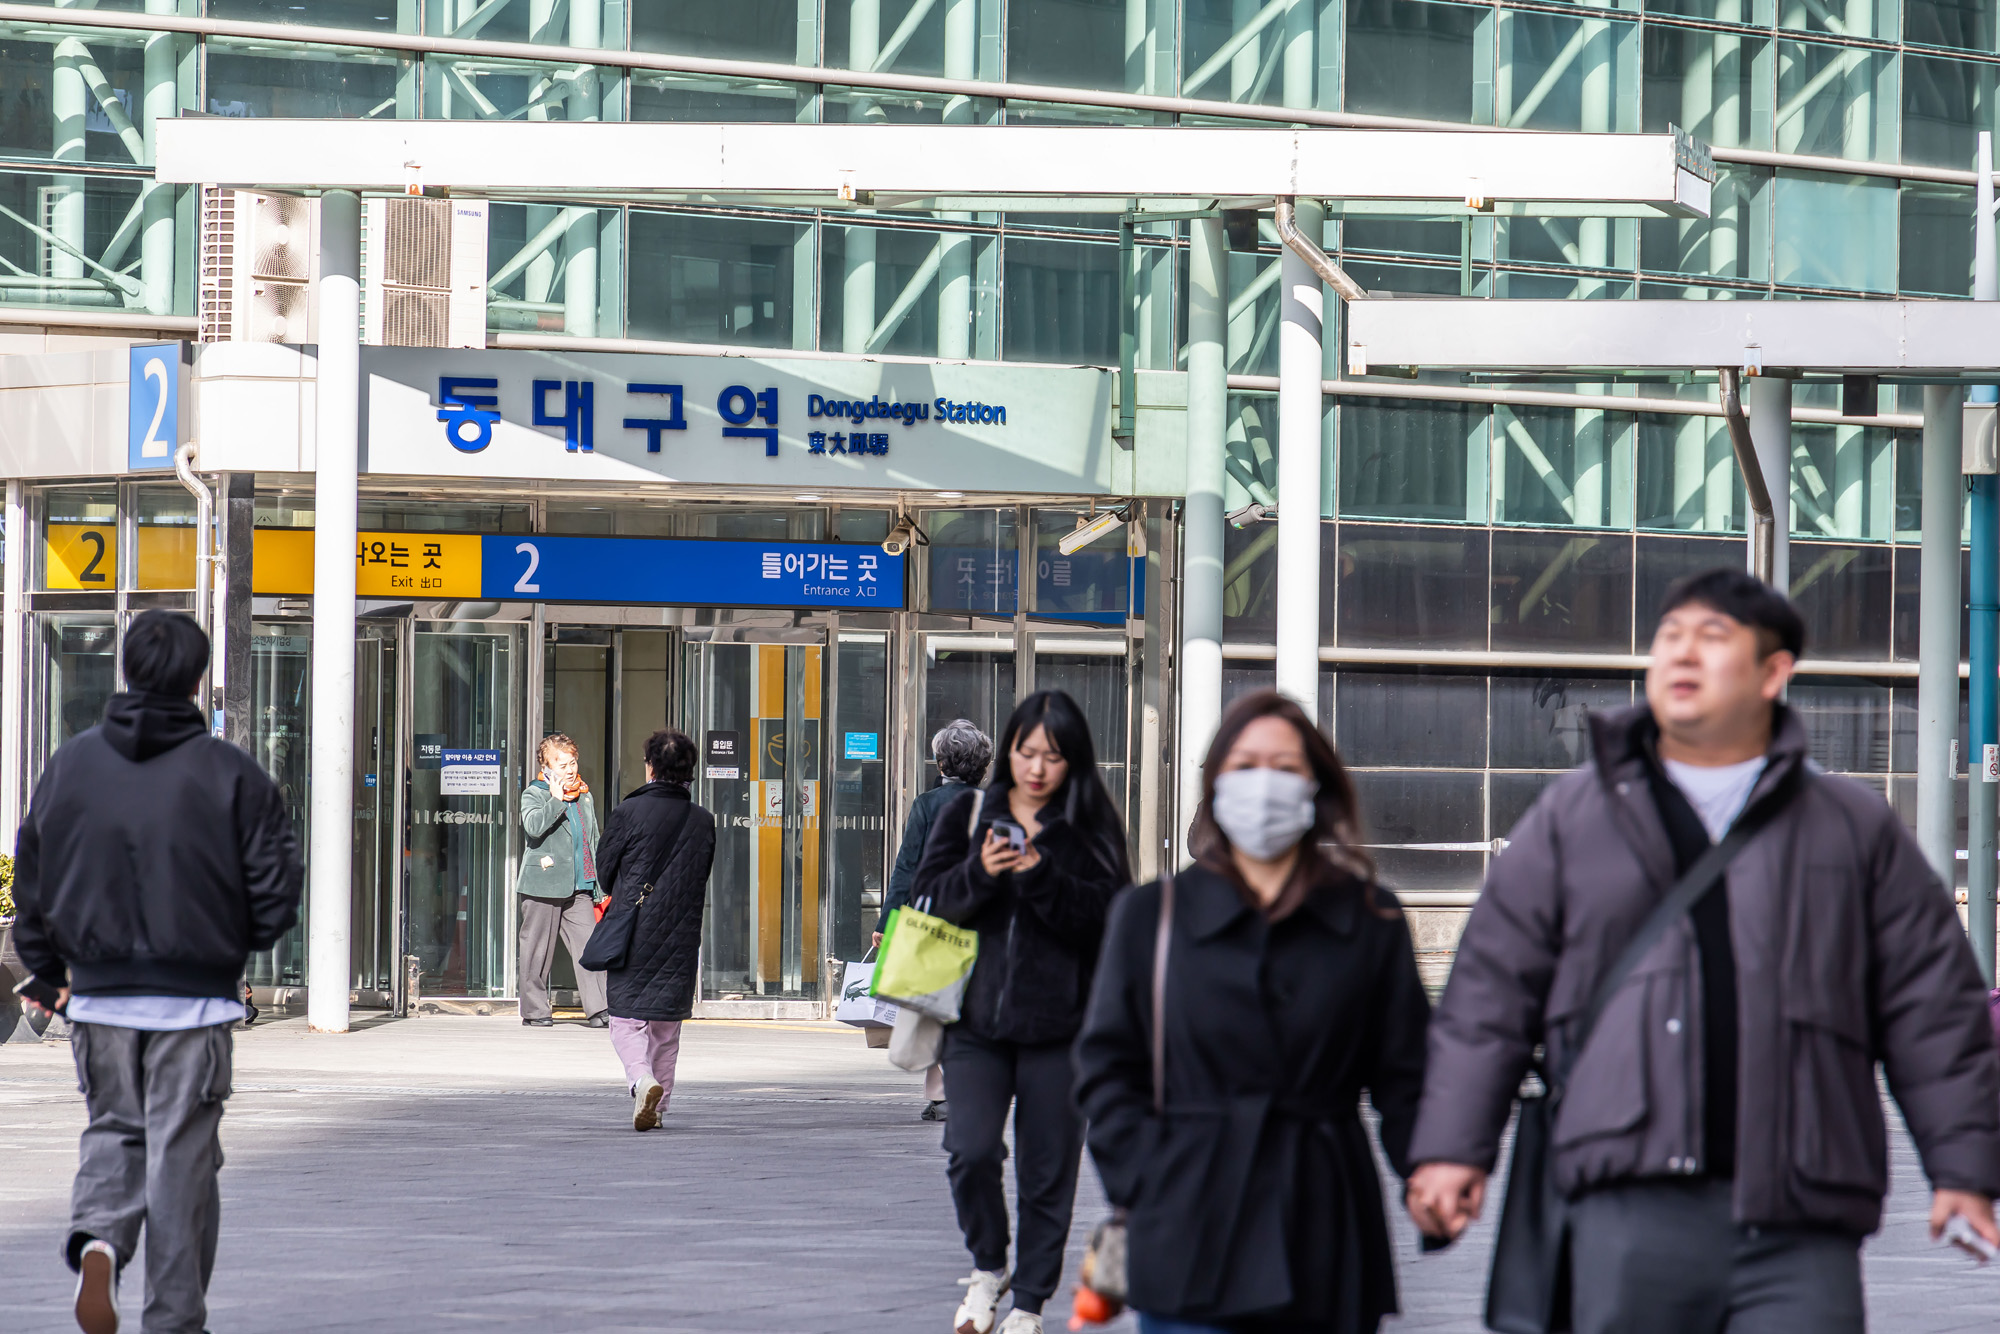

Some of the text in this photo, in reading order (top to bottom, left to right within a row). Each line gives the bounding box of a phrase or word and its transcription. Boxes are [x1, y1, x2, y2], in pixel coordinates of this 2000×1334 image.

[457, 209, 481, 217] SAMSUNG
[142, 357, 168, 458] 2
[808, 394, 1006, 426] Dongdaegu Station
[79, 531, 106, 582] 2
[423, 543, 442, 569] 곳
[514, 542, 540, 593] 2
[761, 552, 878, 582] 들어가는 곳
[391, 575, 442, 589] Exit 出口
[803, 584, 877, 597] Entrance 入口
[713, 740, 733, 750] 출입문
